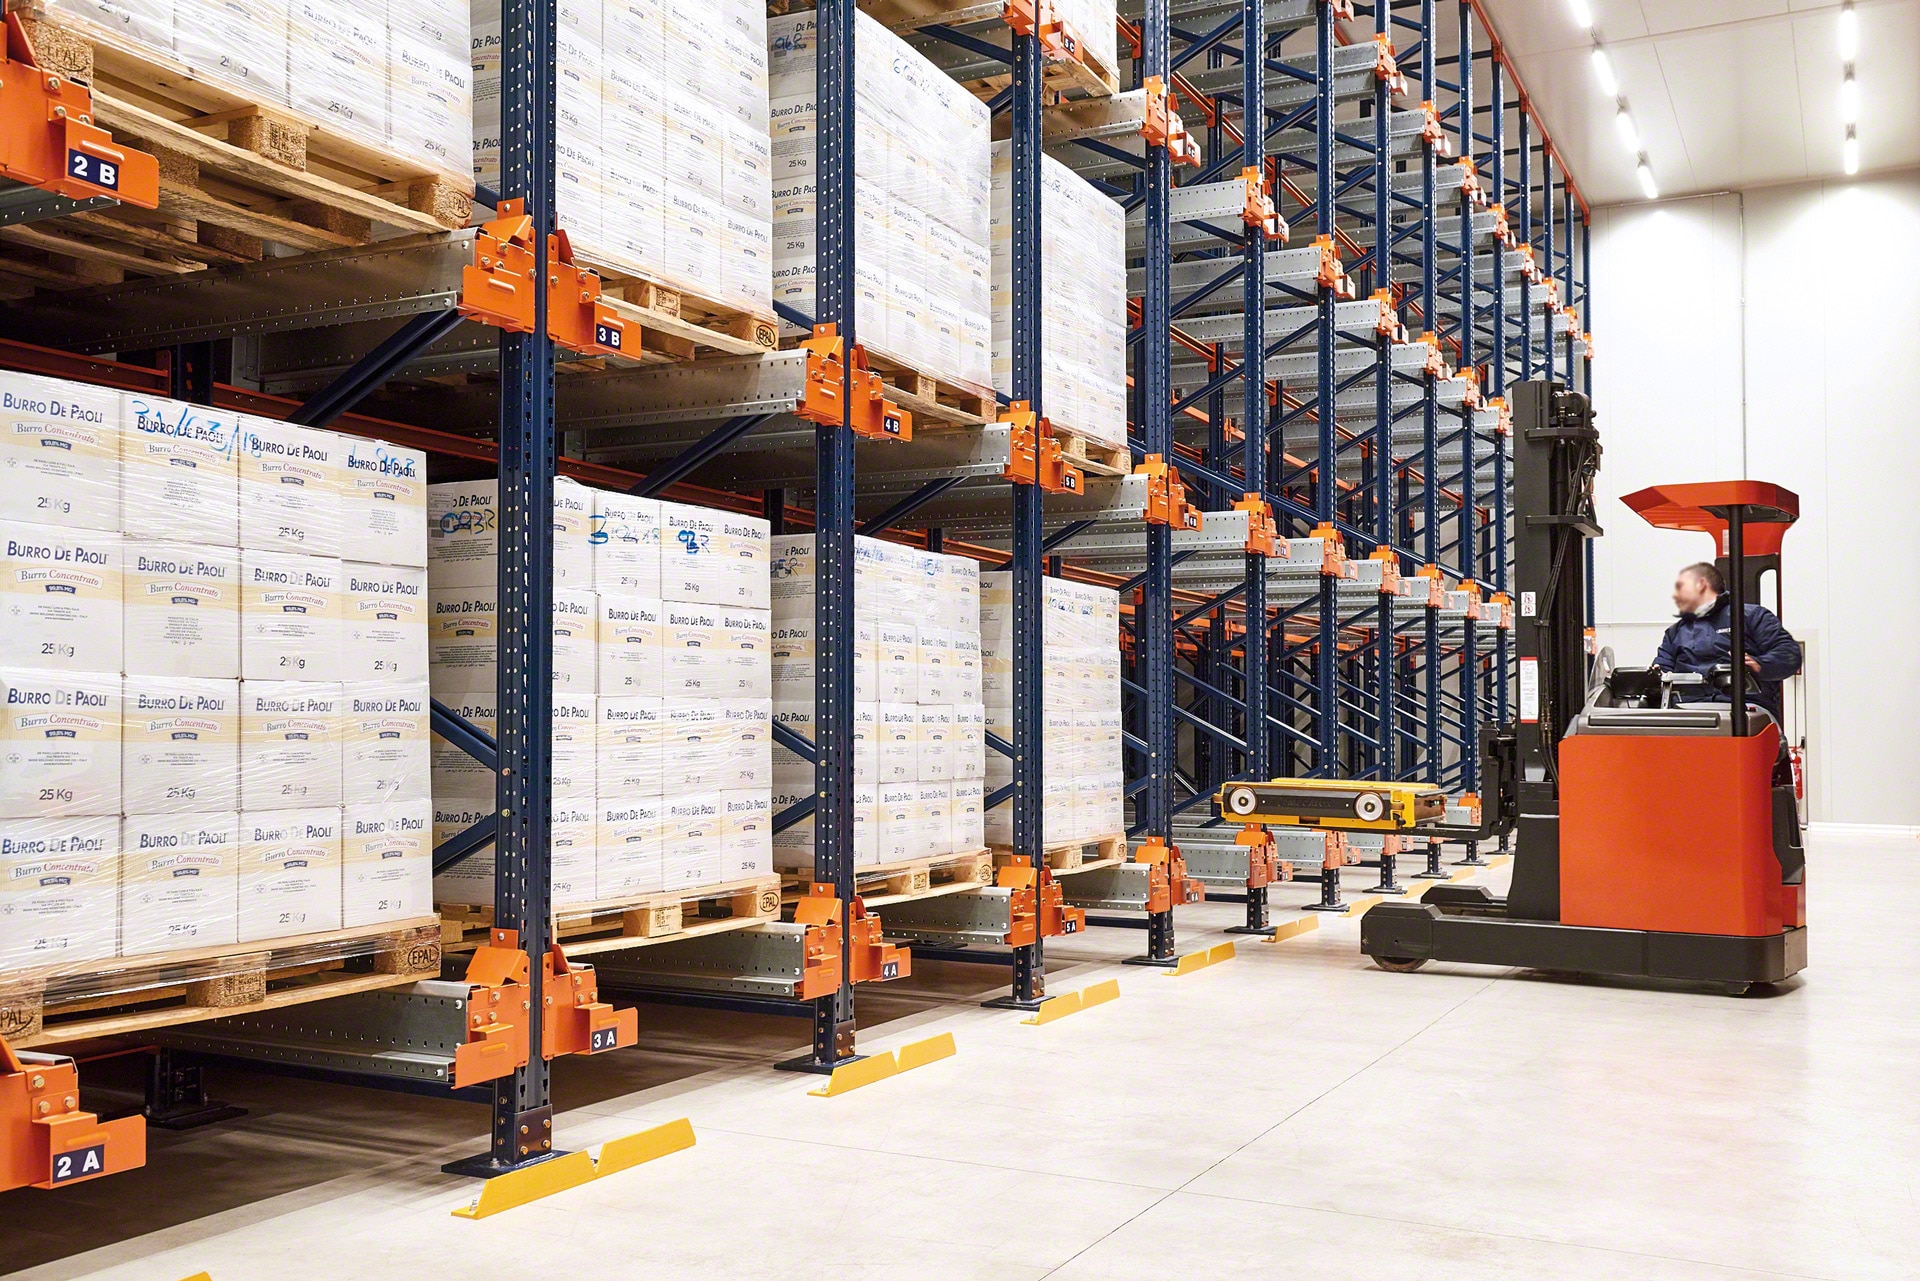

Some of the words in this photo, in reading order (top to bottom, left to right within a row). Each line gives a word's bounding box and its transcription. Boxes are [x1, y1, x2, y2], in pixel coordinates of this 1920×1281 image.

[73, 155, 88, 177] 2
[99, 163, 116, 185] B
[598, 327, 607, 342] 3
[611, 331, 620, 346] B
[4, 393, 46, 414] BURRO
[50, 401, 66, 417] DE
[71, 404, 102, 423] PAOLI
[17, 424, 42, 433] Burro
[885, 418, 891, 430] 4
[893, 420, 900, 433] B
[252, 438, 284, 454] BURRO
[287, 443, 299, 456] DE
[303, 445, 328, 461] PAOLI
[348, 455, 377, 472] BURRO
[393, 464, 415, 477] PAOLI
[1066, 476, 1070, 486] 5
[1070, 478, 1075, 488] B
[37, 497, 51, 508] 25
[54, 500, 70, 513] Kg
[459, 496, 469, 506] DE
[471, 495, 491, 506] PAOLI
[279, 527, 289, 536] 25
[8, 540, 50, 559] BURRO
[55, 546, 71, 561] DE
[75, 548, 107, 565] PAOLI
[138, 557, 175, 573] BURRO
[179, 561, 193, 575] DE
[197, 562, 225, 577] PAOLI
[21, 571, 47, 580] Burro
[49, 570, 98, 585] Concentrato
[254, 568, 287, 584] BURRO
[306, 573, 330, 587] PAOLI
[150, 584, 173, 593] Burro
[175, 583, 218, 596] Concentrato
[351, 578, 379, 592] BURRO
[382, 581, 393, 593] DE
[396, 582, 418, 595] PAOLI
[437, 603, 459, 613] BURRO
[462, 602, 472, 612] DE
[475, 601, 494, 611] PAOLI
[779, 630, 788, 638] DE
[41, 643, 55, 654] 25
[58, 644, 74, 657] Kg
[280, 657, 291, 666] 25
[8, 688, 50, 704] BURRO
[55, 690, 71, 705] DE
[75, 691, 107, 706] PAOLI
[138, 695, 175, 709] BURRO
[179, 696, 193, 709] DE
[197, 696, 224, 710] PAOLI
[256, 698, 289, 711] BURRO
[307, 699, 332, 712] PAOLI
[353, 700, 382, 711] BURRO
[385, 700, 396, 711] DE
[399, 700, 420, 711] PAOLI
[151, 721, 173, 730] Burro
[175, 718, 217, 730] Concentrato
[791, 713, 809, 721] PAOLI
[39, 789, 54, 800] 25
[56, 789, 73, 801] Kg
[255, 828, 288, 841] BURRO
[307, 825, 332, 838] PAOLI
[356, 821, 385, 834] BURRO
[388, 819, 399, 830] DE
[402, 818, 423, 830] PAOLI
[2, 839, 45, 854] BURRO
[50, 838, 66, 852] DE
[70, 837, 103, 851] PAOLI
[140, 834, 177, 848] BURRO
[199, 831, 227, 845] PAOLI
[152, 859, 175, 869] Burro
[1066, 922, 1070, 932] 5
[1072, 922, 1076, 931] A
[413, 950, 433, 965] EPAL
[884, 965, 889, 977] 4
[890, 964, 897, 976] A
[0, 1009, 26, 1028] PAL
[593, 1033, 602, 1048] 3
[606, 1030, 616, 1046] A
[57, 1156, 72, 1178] 2
[82, 1150, 100, 1172] A
